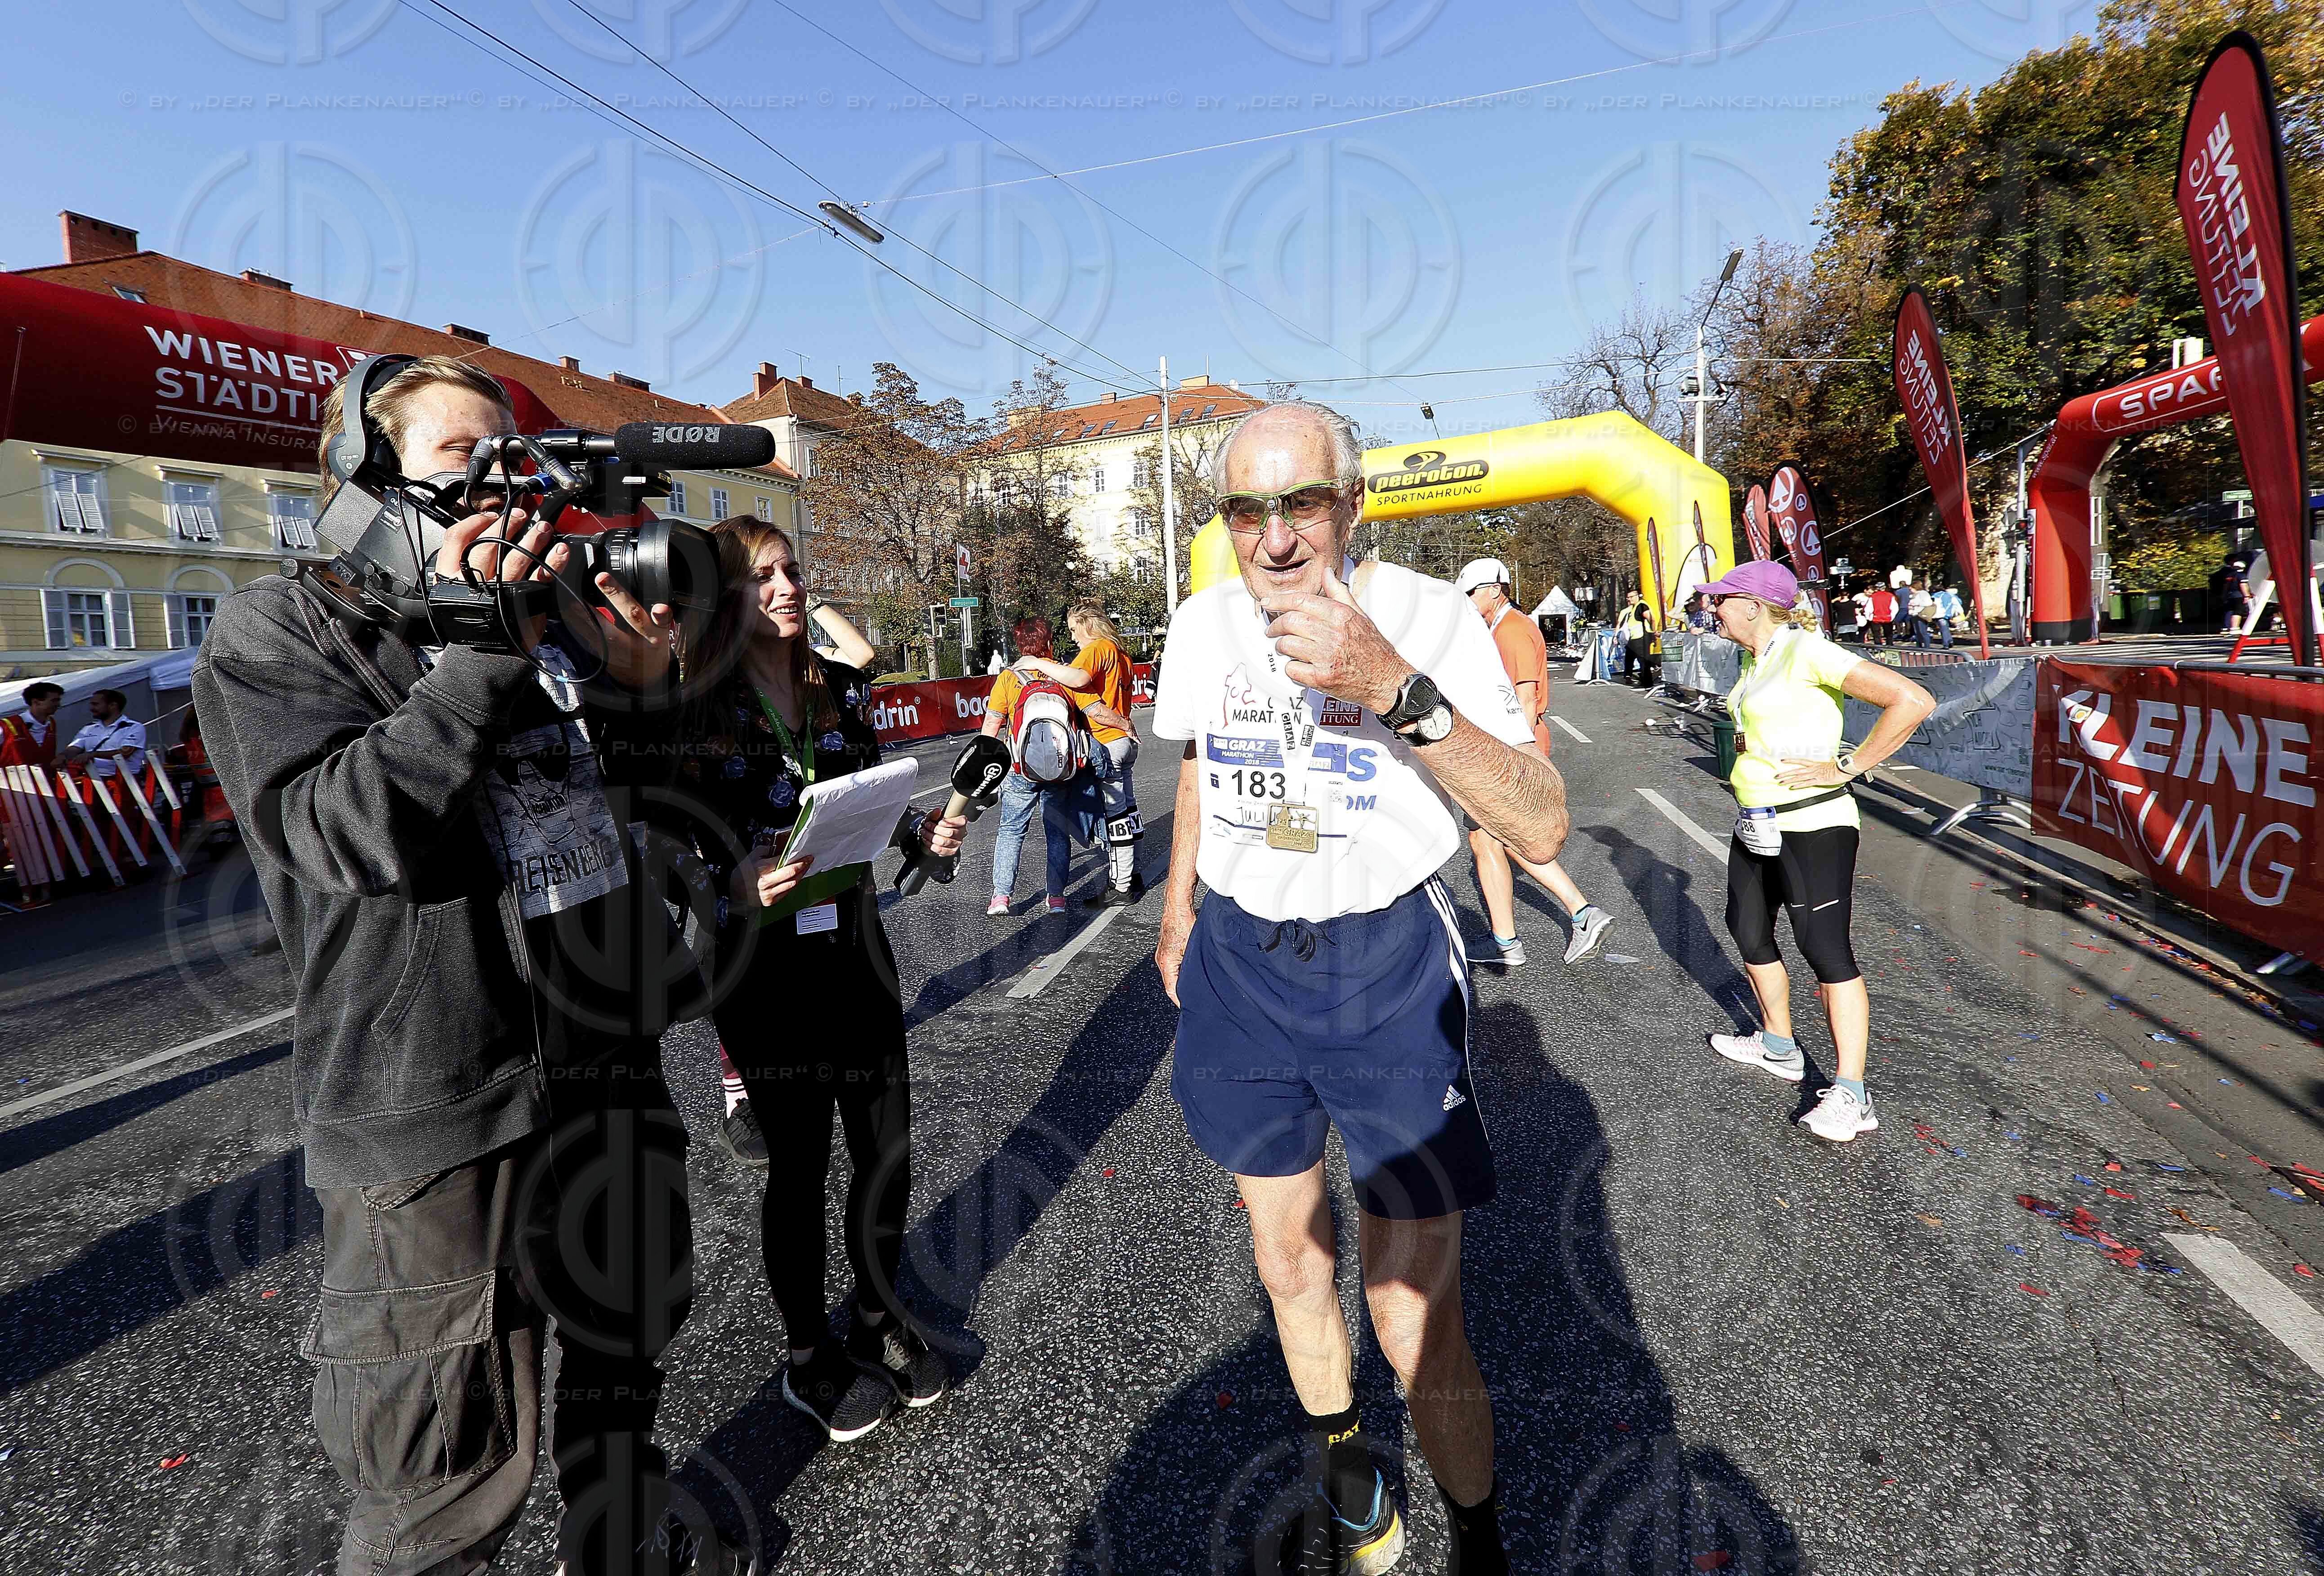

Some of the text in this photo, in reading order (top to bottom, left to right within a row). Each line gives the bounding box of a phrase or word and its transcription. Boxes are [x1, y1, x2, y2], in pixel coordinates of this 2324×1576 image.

[143, 325, 339, 385] WIENER
[155, 367, 317, 421] STÄDTI
[652, 426, 720, 443] RØDE
[1377, 484, 1482, 506] SPORTNAHRUNG
[1268, 653, 1276, 672] 2018
[1323, 700, 1359, 712] EINE
[1233, 709, 1301, 725] MARATN
[1320, 715, 1359, 724] ITUNG
[1282, 713, 1295, 750] GRAZ
[1229, 739, 1267, 752] GRAZ
[2053, 683, 2316, 807] KLEINE
[1232, 770, 1285, 799] 183
[2058, 758, 2302, 906] ZEITUNG
[1443, 1095, 1466, 1111] adidas
